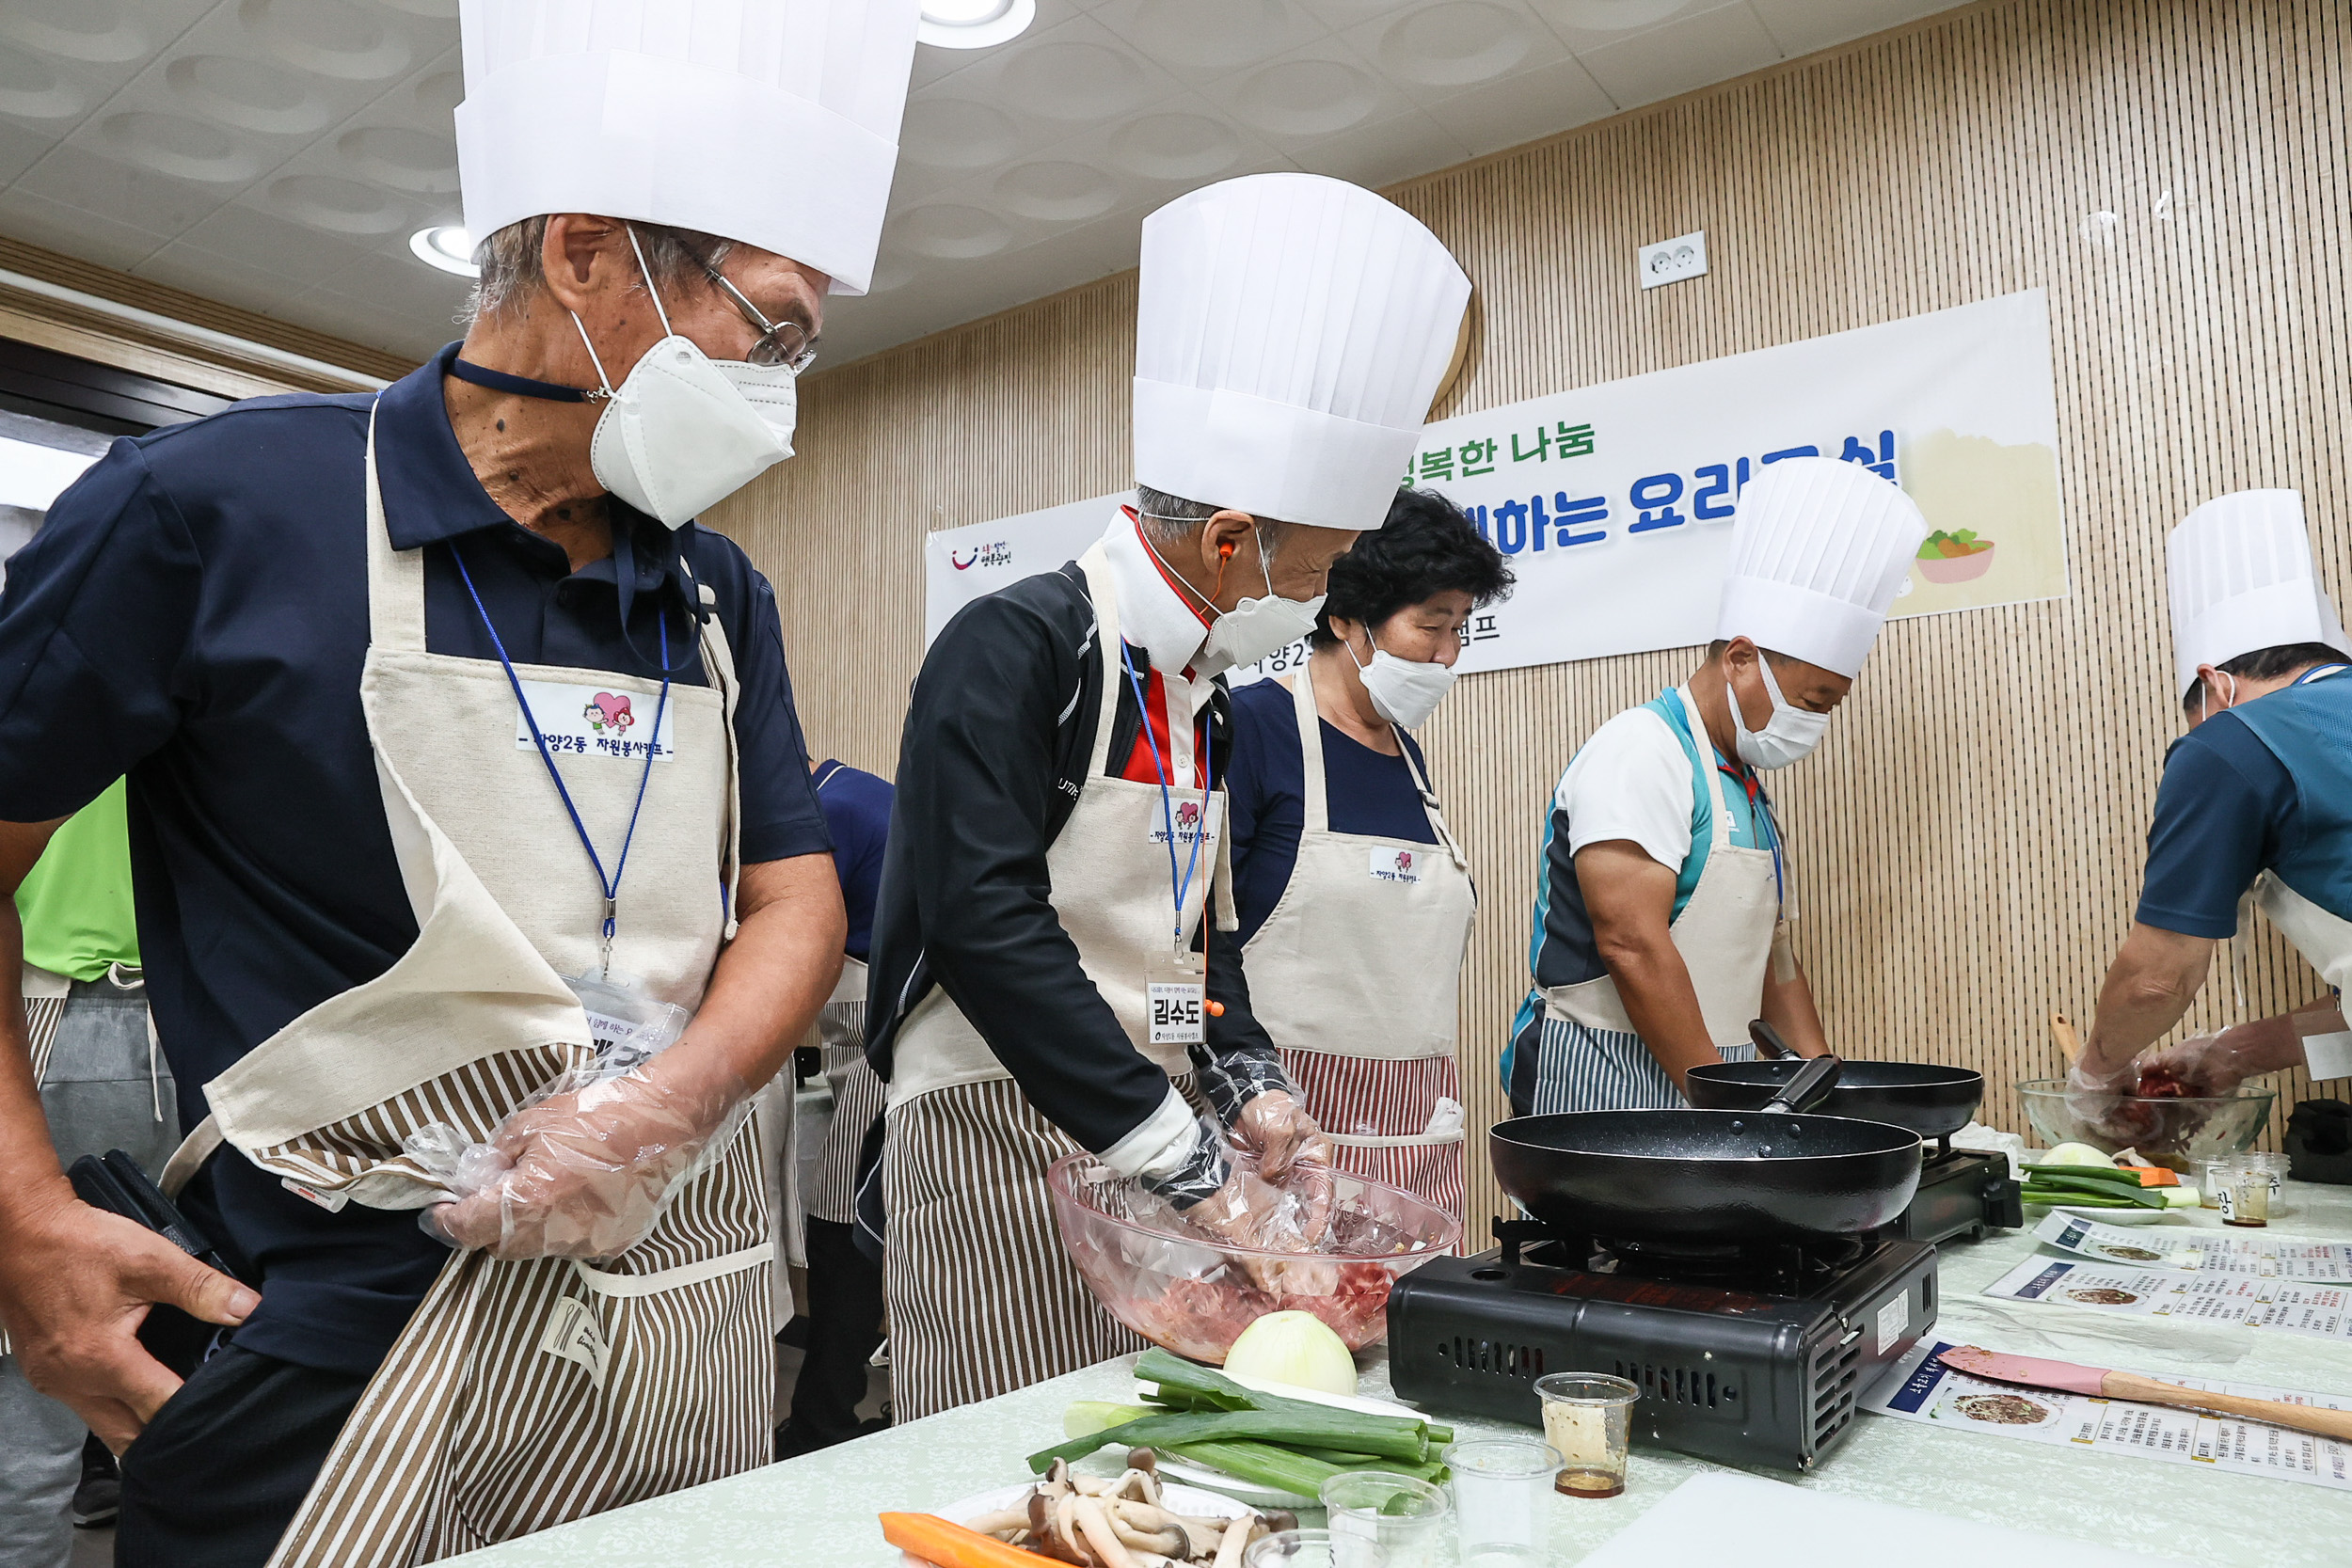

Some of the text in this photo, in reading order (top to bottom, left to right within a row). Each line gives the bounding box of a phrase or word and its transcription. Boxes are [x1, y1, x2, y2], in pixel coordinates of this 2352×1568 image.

[1511, 420, 1595, 463] 나눔
[1628, 430, 1897, 533] 요리실
[610, 1023, 624, 1035] 하는
[1154, 999, 1199, 1025] 김수도
